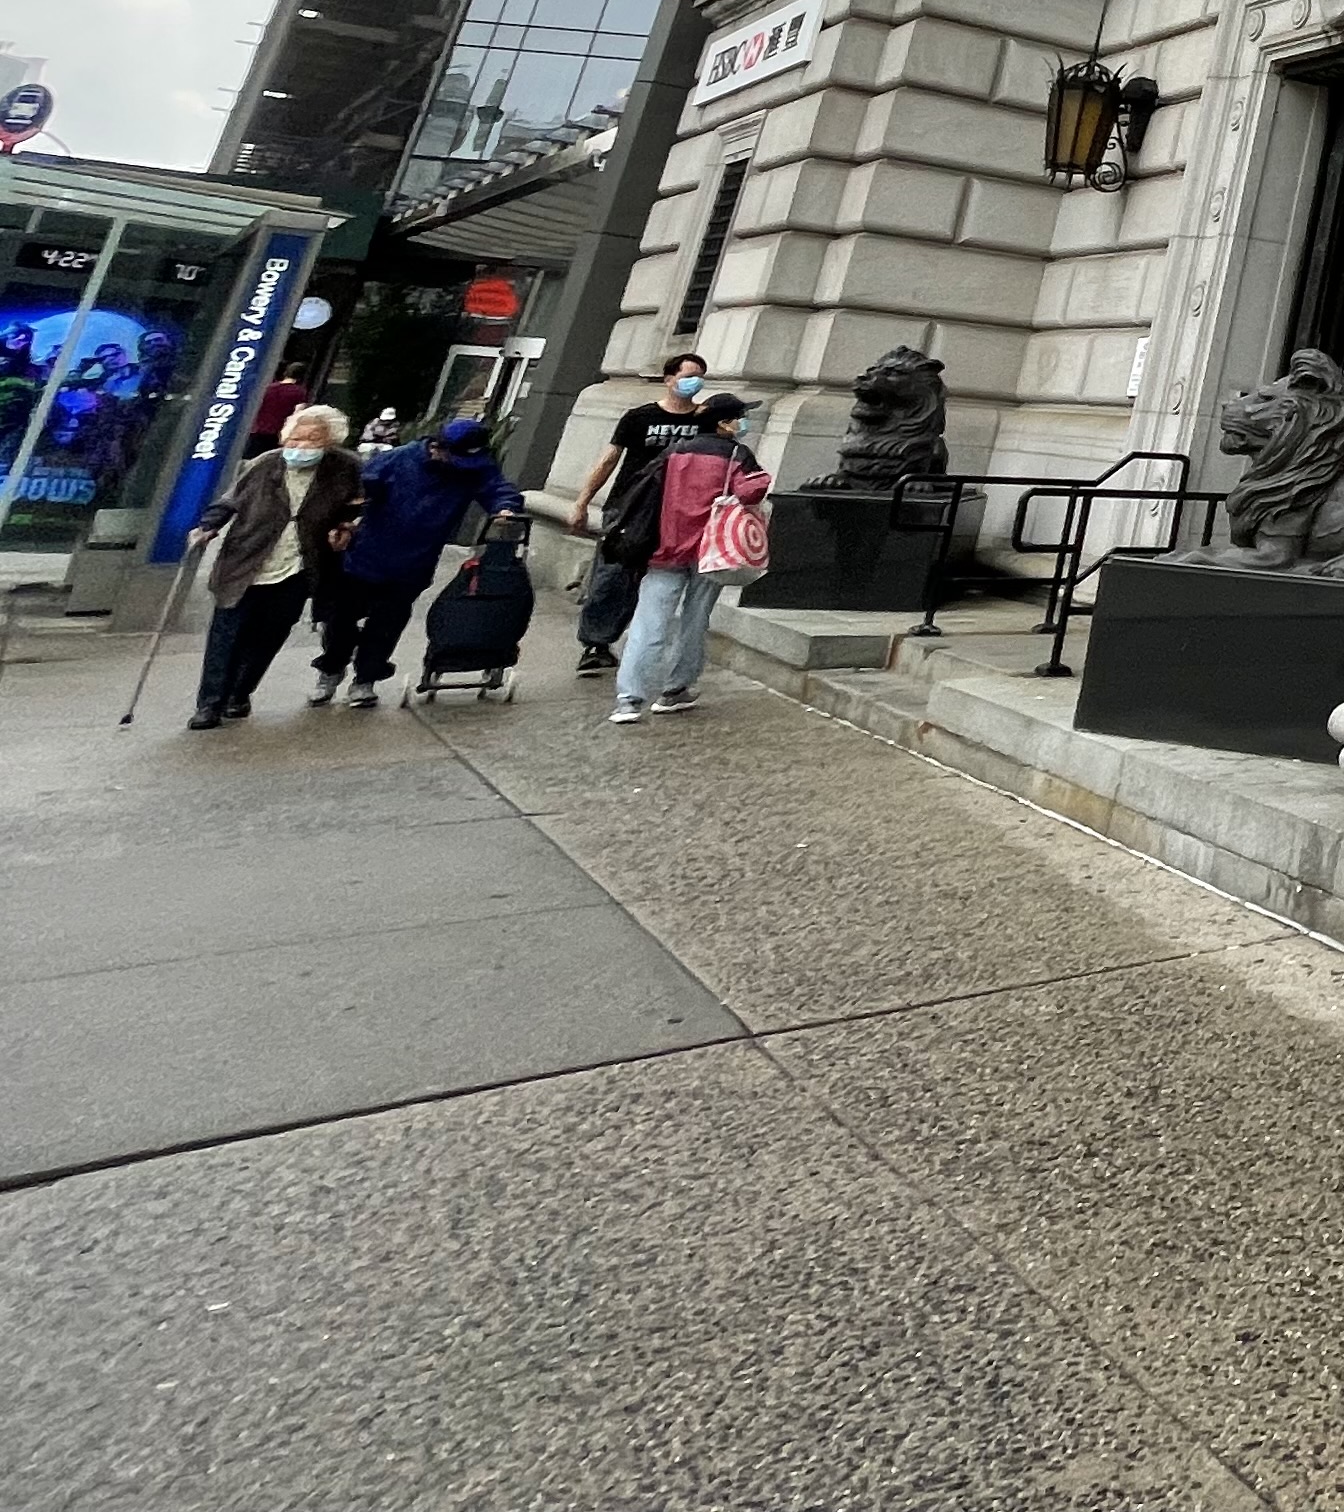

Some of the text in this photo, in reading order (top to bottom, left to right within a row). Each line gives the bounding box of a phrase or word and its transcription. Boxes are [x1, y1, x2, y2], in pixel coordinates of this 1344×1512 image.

[192, 257, 289, 461] Bowery & Canal Street
